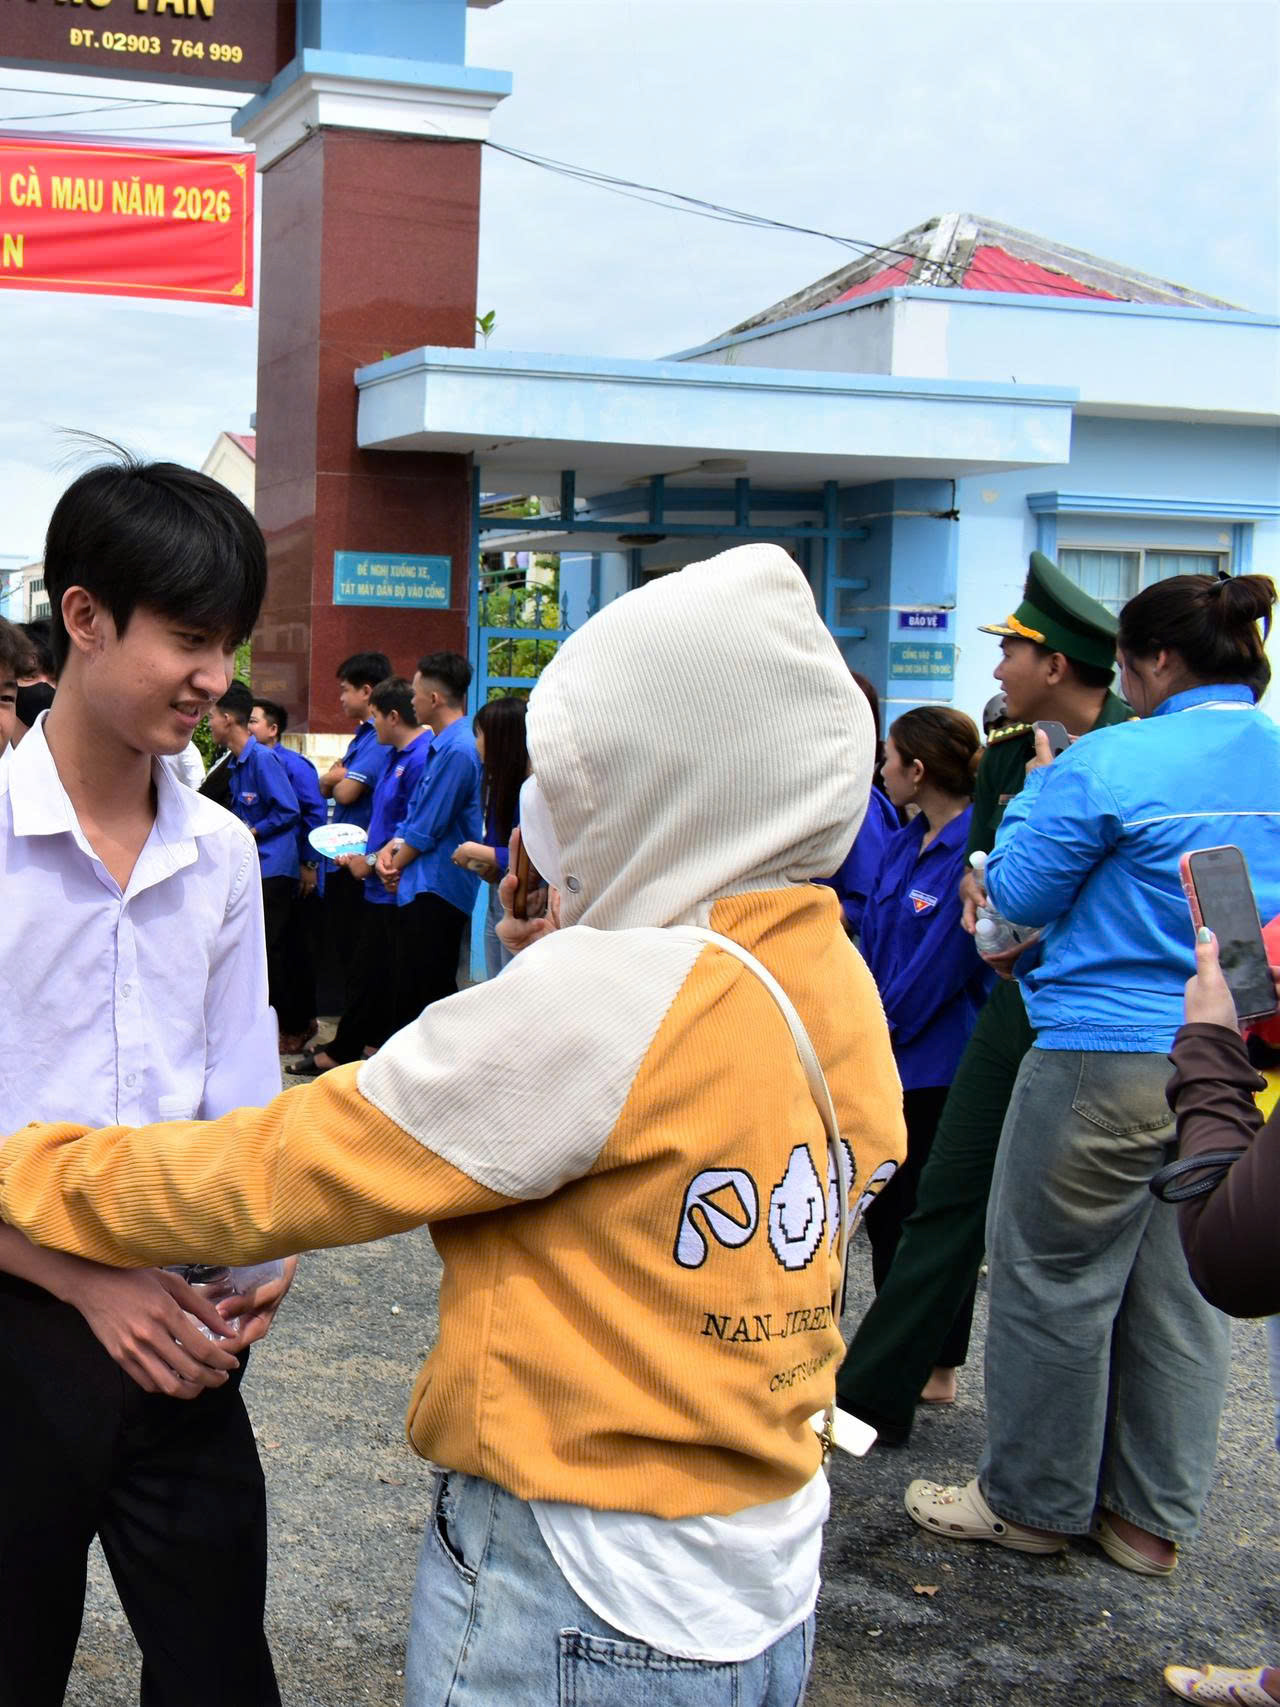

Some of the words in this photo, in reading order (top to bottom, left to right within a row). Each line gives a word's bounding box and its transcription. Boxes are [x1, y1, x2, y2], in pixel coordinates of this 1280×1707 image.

[171, 39, 205, 60] 764
[209, 43, 243, 63] 999
[9, 166, 42, 208] CÀ
[51, 176, 104, 213] MAU
[112, 176, 165, 217] NĂM
[172, 187, 231, 223] 2026
[908, 613, 926, 627] BẢO
[927, 614, 938, 627] VỆ
